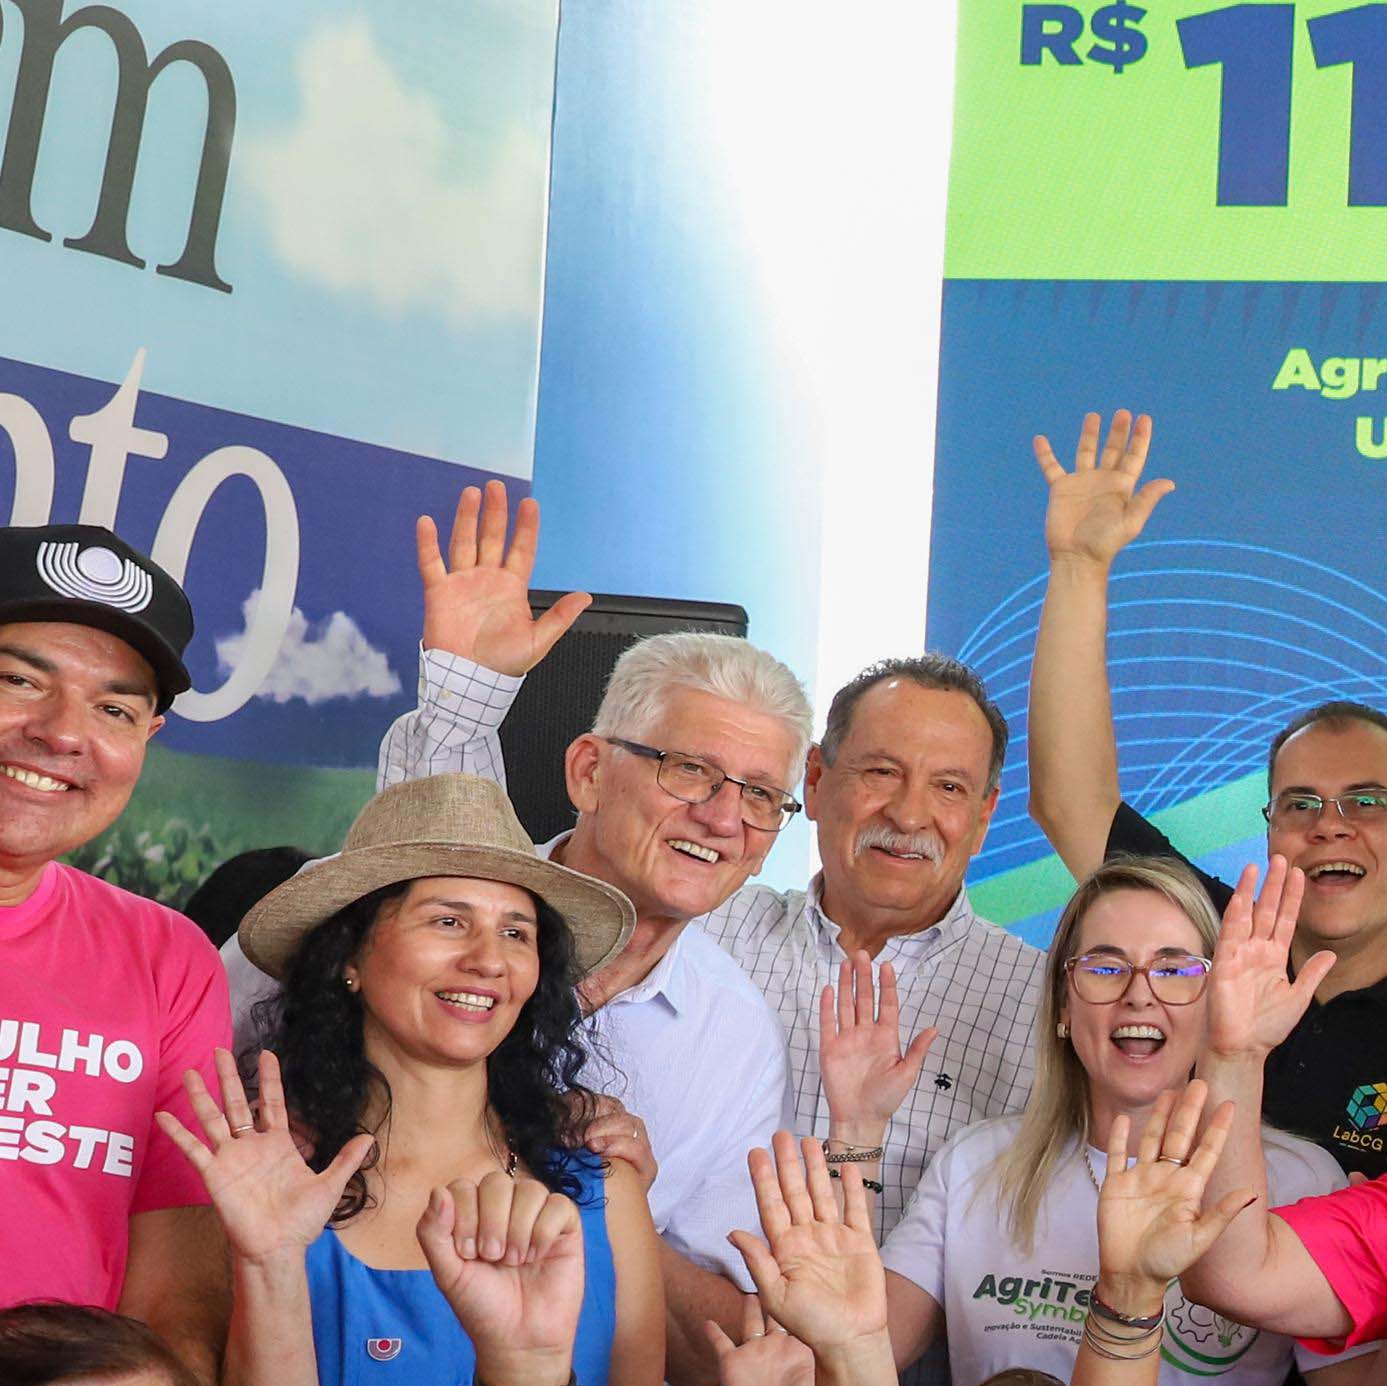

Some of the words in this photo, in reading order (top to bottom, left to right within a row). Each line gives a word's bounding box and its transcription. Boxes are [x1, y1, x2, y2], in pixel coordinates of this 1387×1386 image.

[1020, 0, 1149, 73] R$
[1332, 1125, 1384, 1152] LabCG
[1041, 1269, 1072, 1278] Somos
[1072, 1273, 1098, 1282] REDE
[972, 1273, 1092, 1307] AgriTe
[1013, 1298, 1089, 1323] Symb
[1029, 1323, 1082, 1337] Sustentabil
[1036, 1332, 1068, 1342] Cadeia
